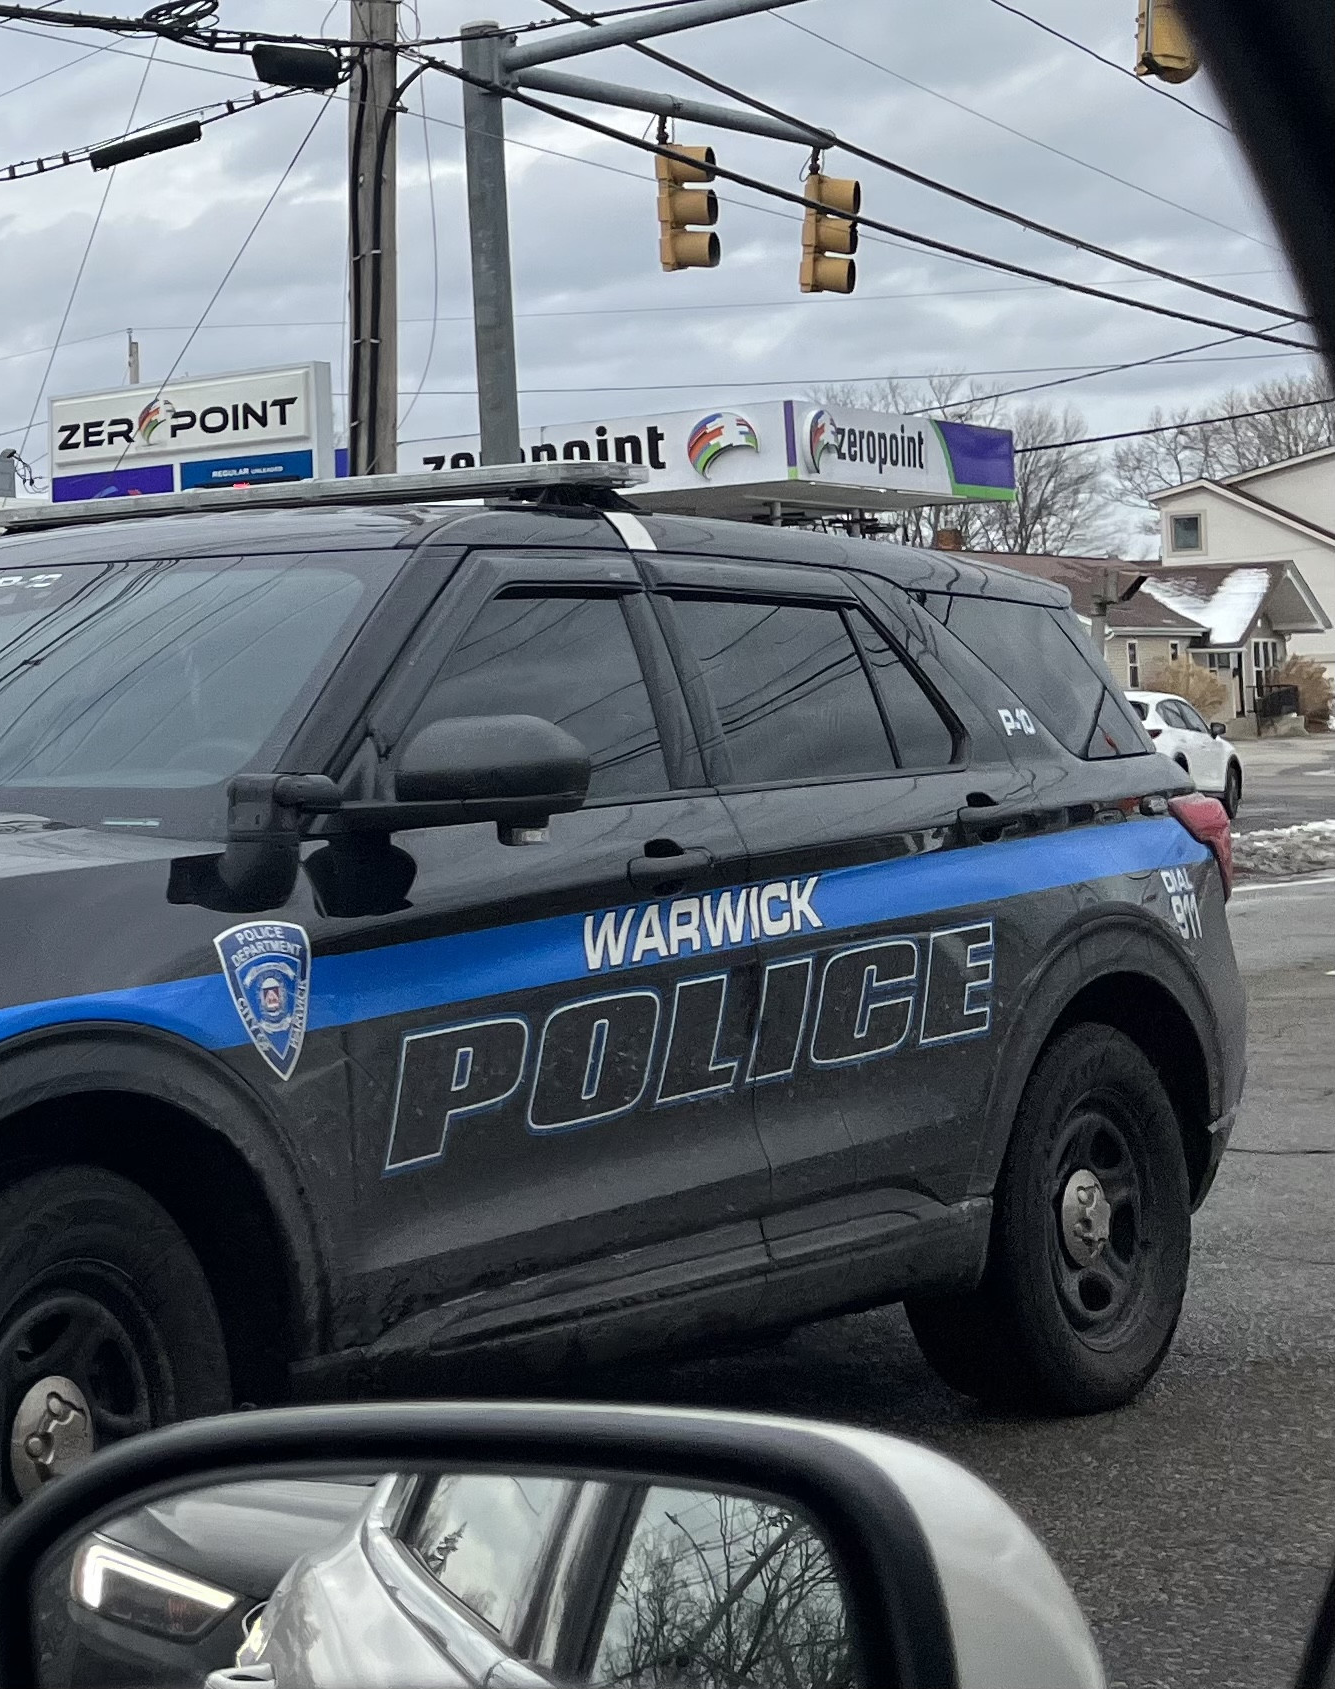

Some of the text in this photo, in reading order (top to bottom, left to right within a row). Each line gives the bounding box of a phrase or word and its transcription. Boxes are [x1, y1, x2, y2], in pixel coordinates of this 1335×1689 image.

[171, 396, 298, 438] POINT
[836, 424, 924, 474] zeropoint
[212, 467, 249, 478] REGULAR
[1160, 867, 1194, 894] DIAL
[235, 927, 285, 944] POLICE
[583, 876, 823, 970] WARWICK
[231, 941, 302, 967] DEPARTMENT
[382, 921, 996, 1178] POLICE
